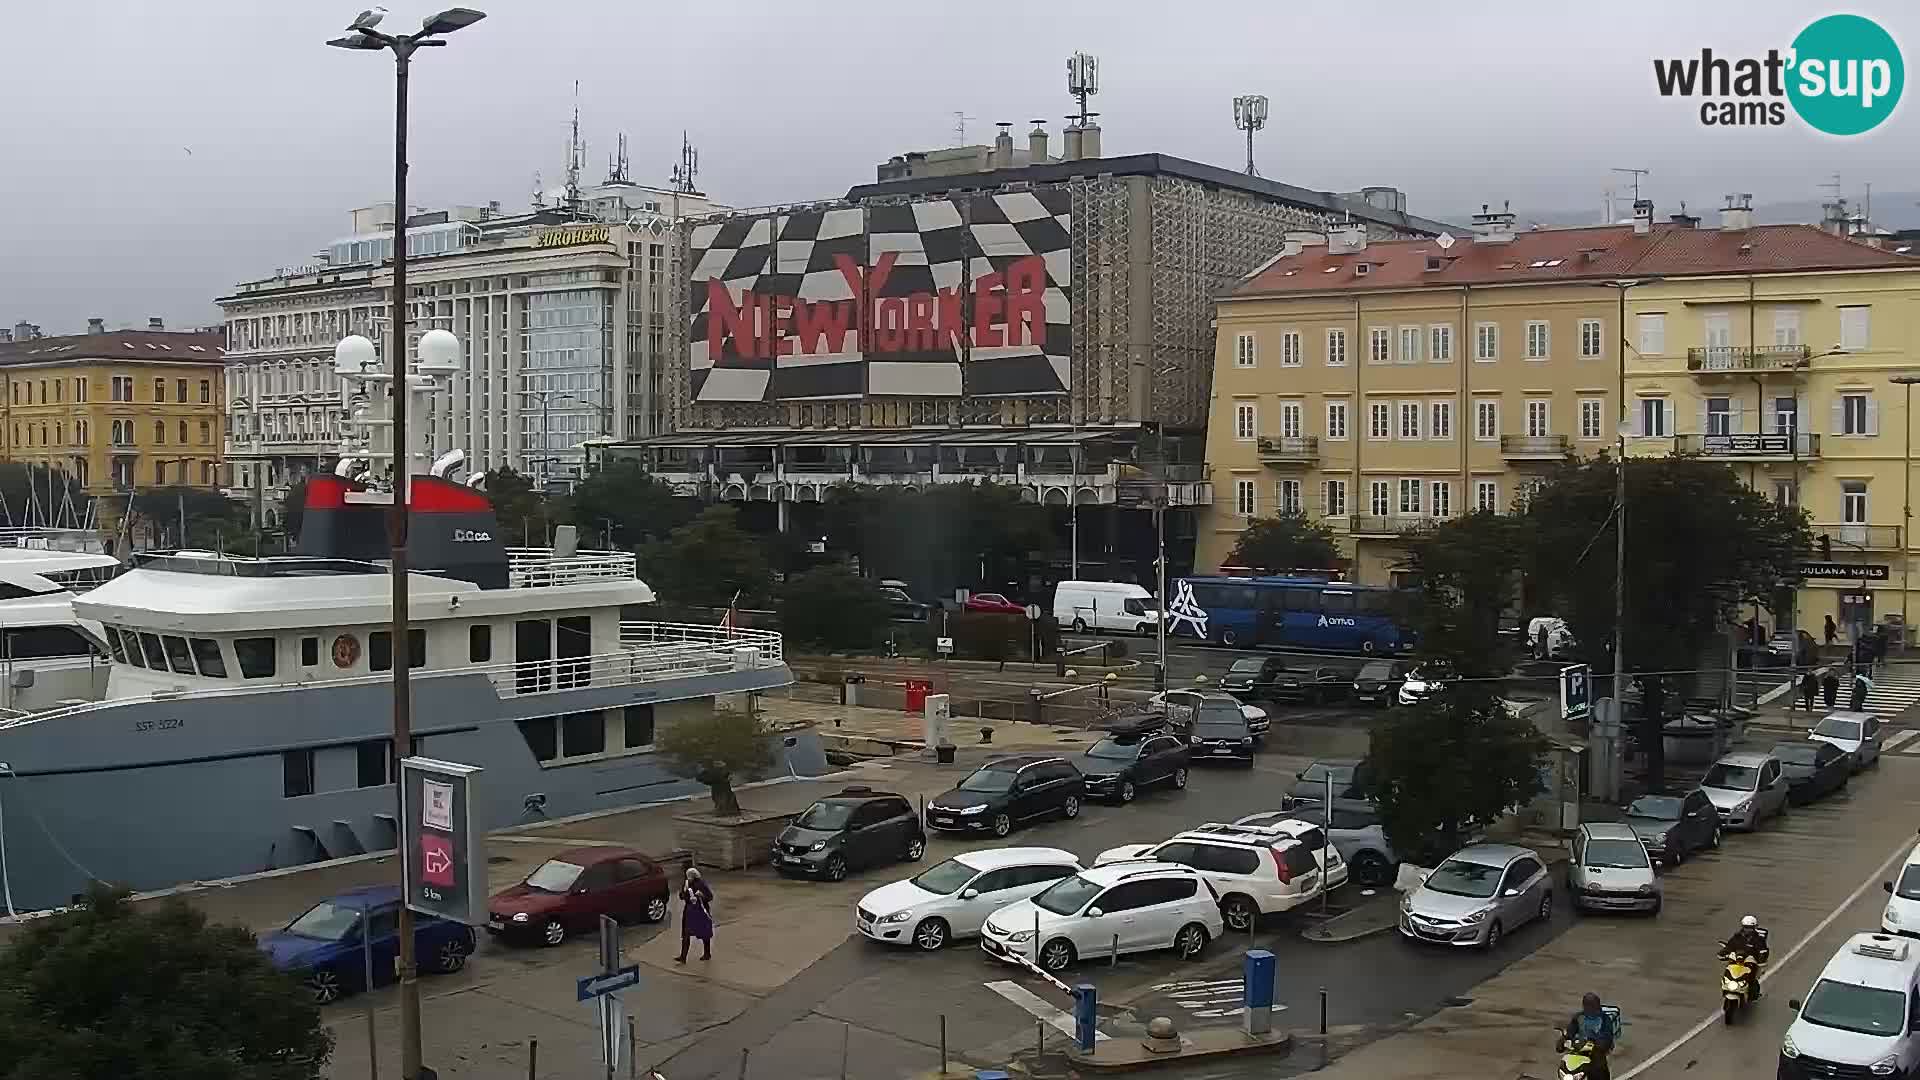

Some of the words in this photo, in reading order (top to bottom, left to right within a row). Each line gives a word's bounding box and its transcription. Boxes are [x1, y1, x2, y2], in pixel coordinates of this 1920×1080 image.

[708, 276, 849, 361] NEW
[832, 251, 1047, 352] YORKER
[1800, 567, 1847, 575] JULIANA
[1851, 568, 1884, 577] NAILS
